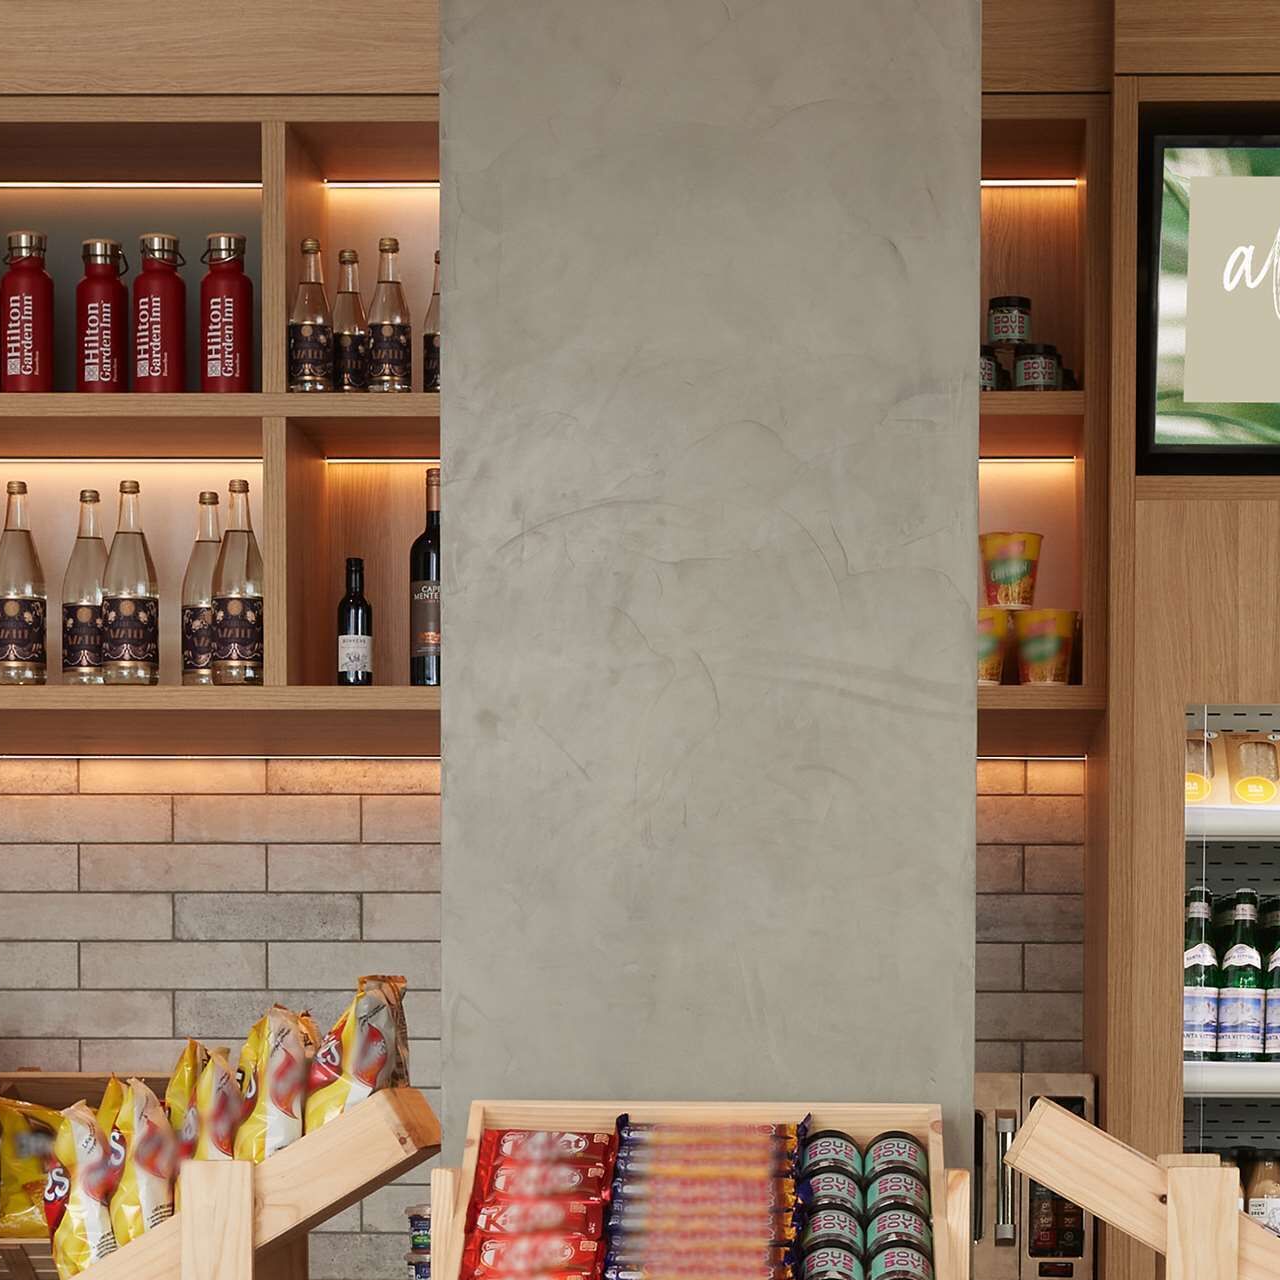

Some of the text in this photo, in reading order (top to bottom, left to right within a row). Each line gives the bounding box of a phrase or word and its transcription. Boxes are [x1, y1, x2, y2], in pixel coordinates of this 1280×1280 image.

[7, 296, 21, 358] Hilton
[21, 296, 33, 375] Garden Inn
[84, 303, 99, 364] Hilton
[100, 303, 111, 382] Garden Inn
[136, 297, 149, 360] Hilton
[150, 296, 161, 376] Garden Inn
[207, 297, 221, 360] Hilton
[222, 297, 234, 377] Garden Inn
[994, 315, 1024, 325] SOUR
[994, 325, 1024, 335] BOYS
